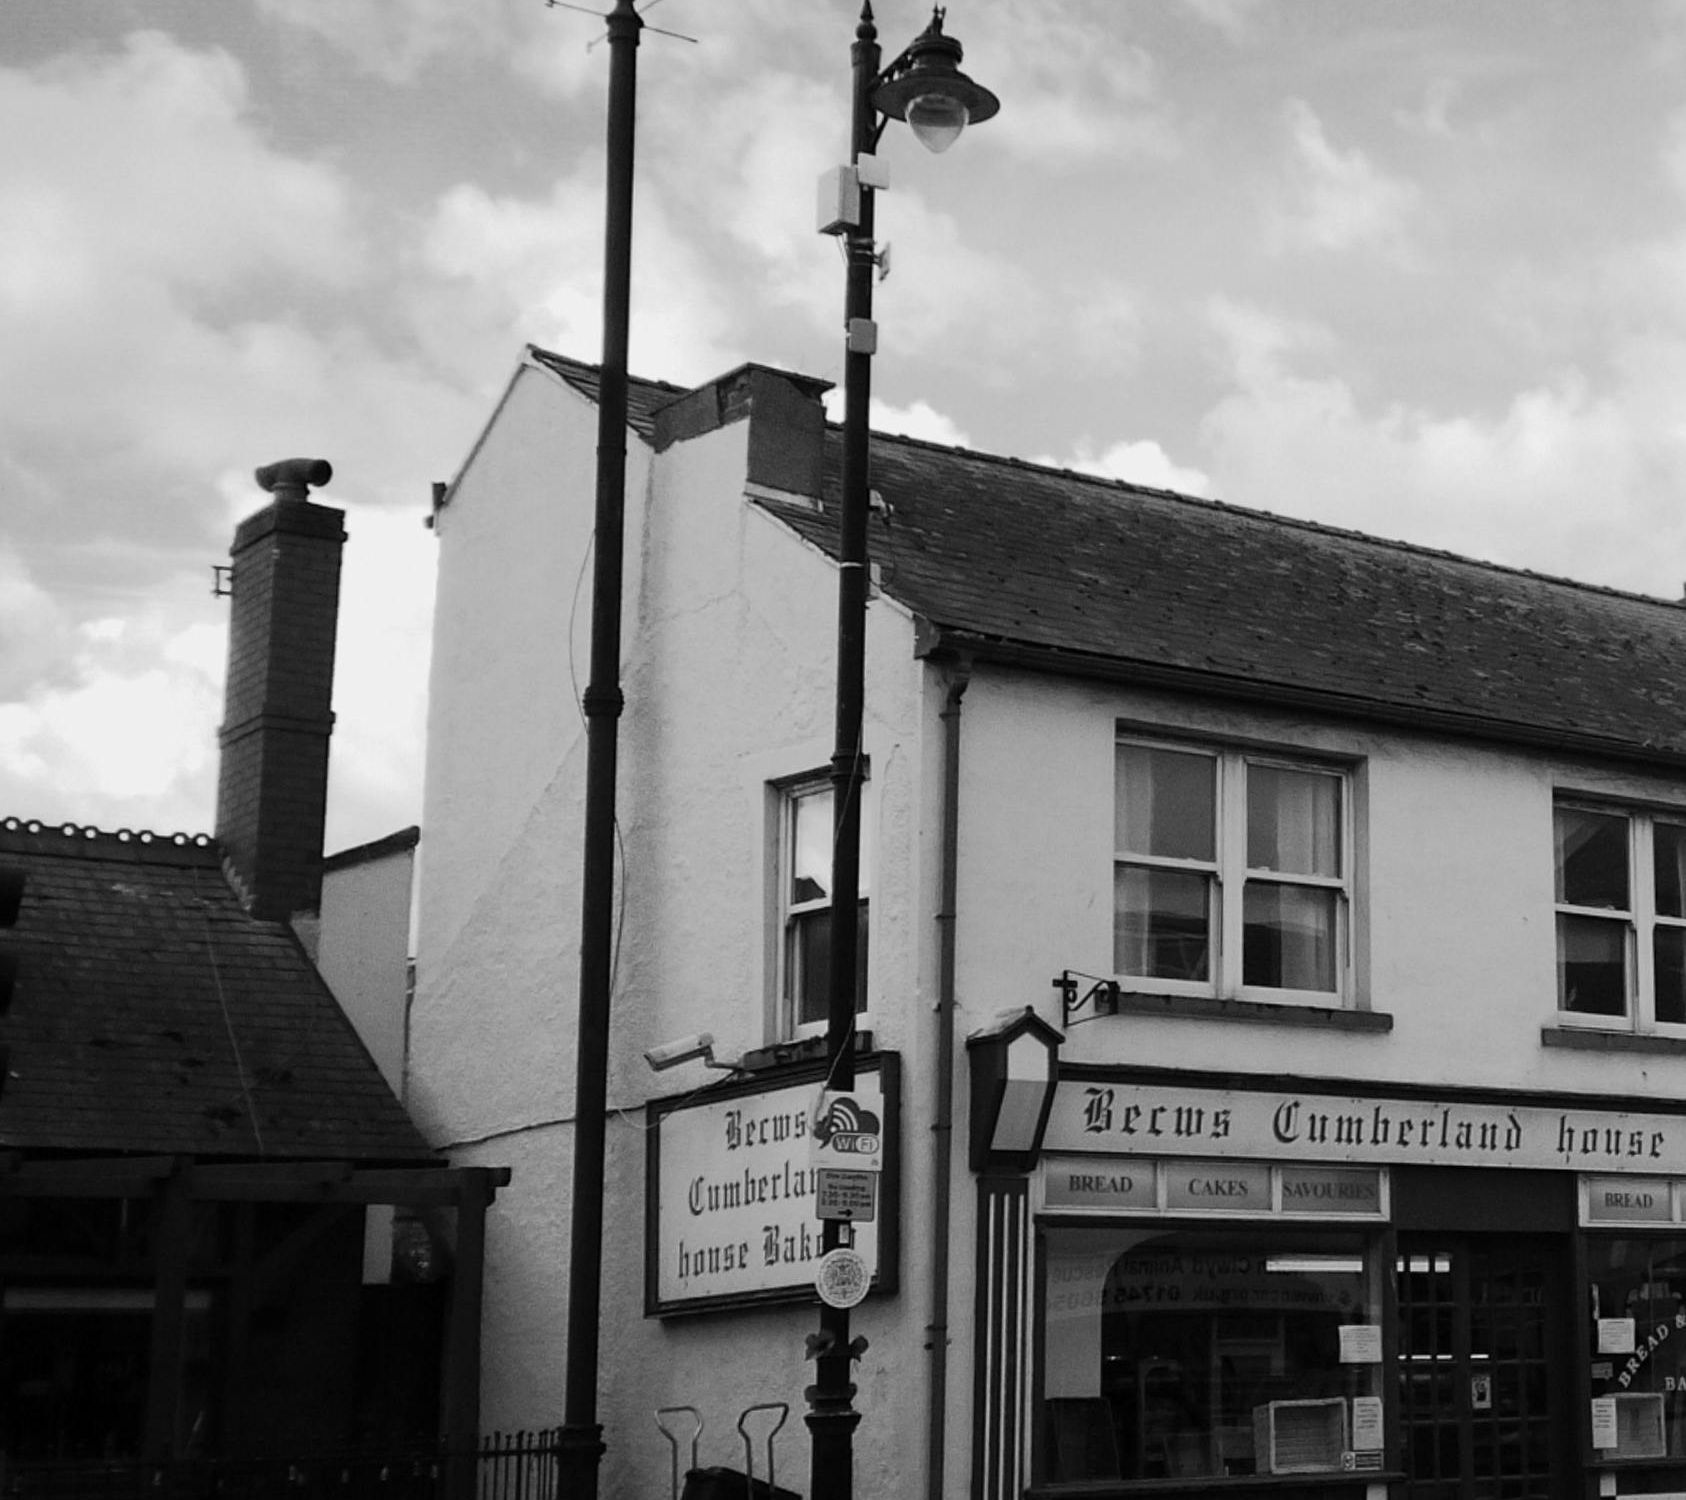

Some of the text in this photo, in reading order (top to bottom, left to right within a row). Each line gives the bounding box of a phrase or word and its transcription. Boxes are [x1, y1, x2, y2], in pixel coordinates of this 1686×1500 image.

[725, 1109, 807, 1151] Becws
[1083, 1086, 1232, 1139] Becws
[1272, 1099, 1523, 1152] Cumberland
[1556, 1115, 1665, 1163] house
[1068, 1175, 1376, 1200] BREAD CAKES SAVOURIES
[1604, 1192, 1653, 1209] BREAD
[678, 1239, 749, 1286] house
[1617, 1324, 1670, 1388] BREAD
[1675, 1314, 1686, 1329] &
